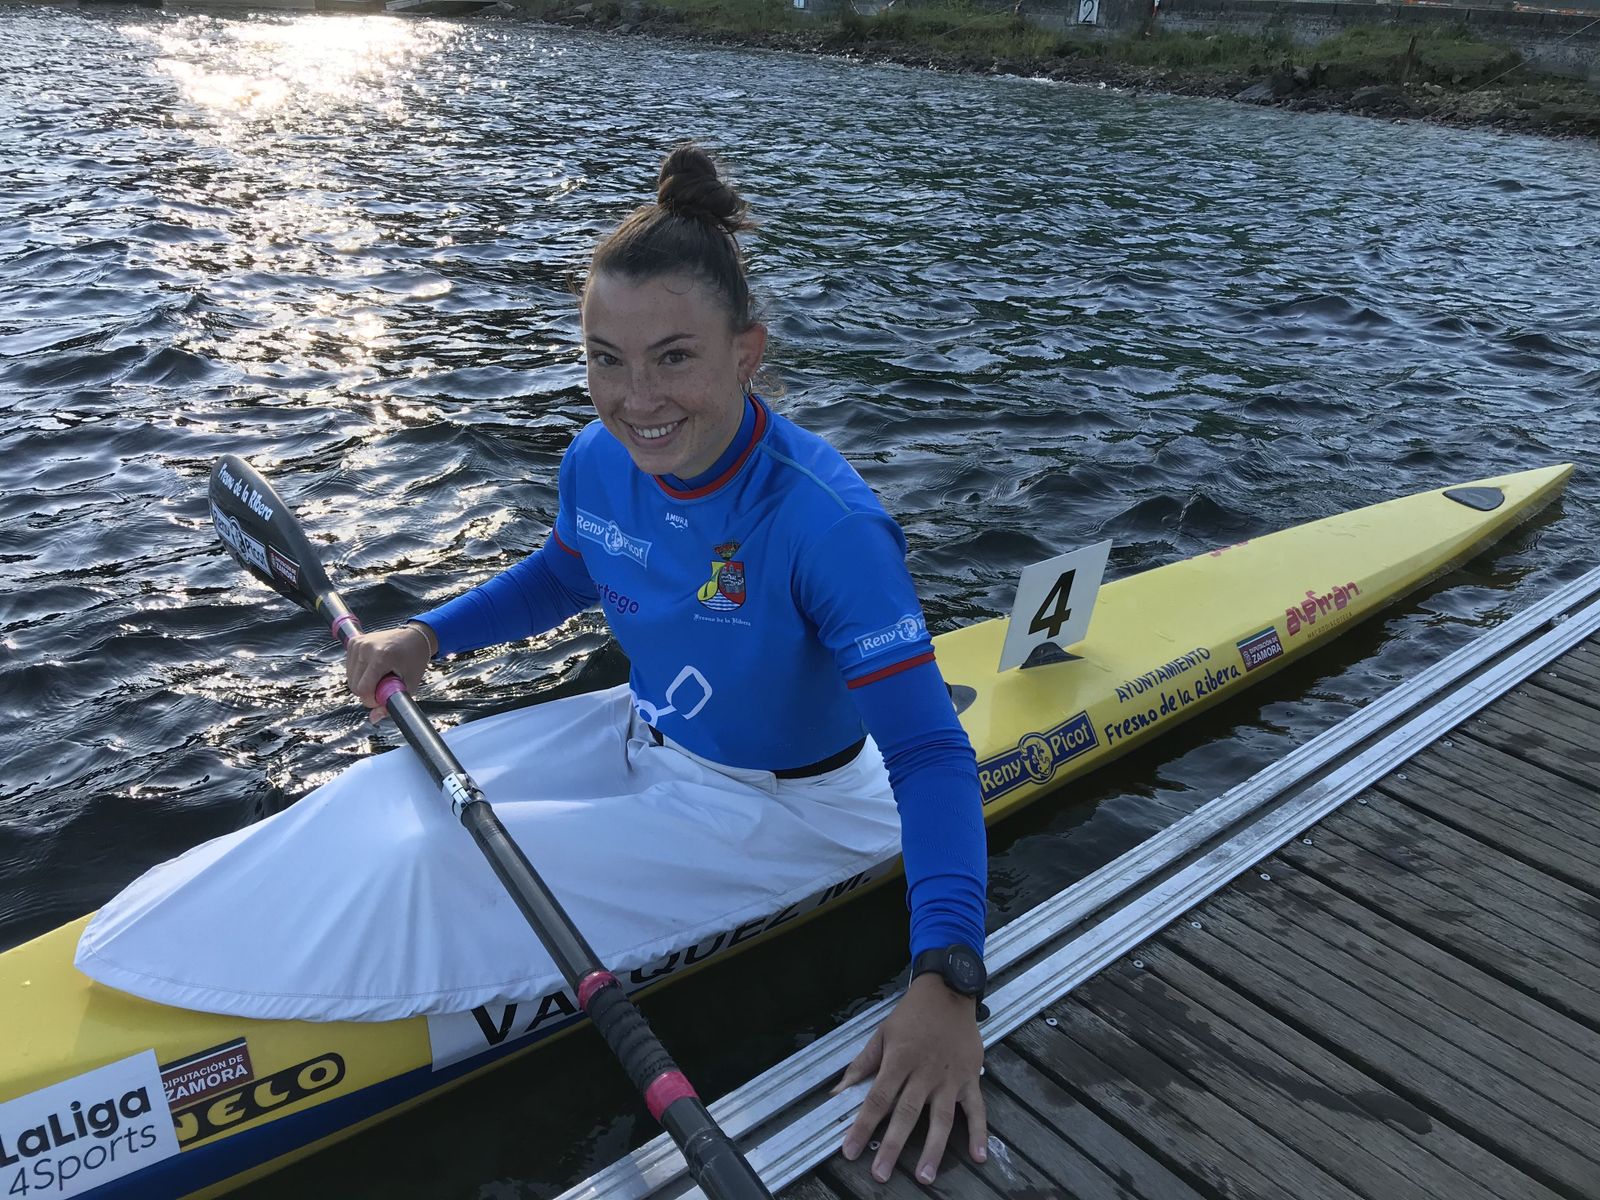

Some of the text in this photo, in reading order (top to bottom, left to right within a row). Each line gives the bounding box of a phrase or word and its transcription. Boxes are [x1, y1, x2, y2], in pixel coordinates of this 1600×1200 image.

[1080, 0, 1095, 23] 2
[241, 484, 249, 504] la
[576, 515, 645, 559] Reny Picot
[665, 512, 688, 528] AMURA
[595, 583, 639, 614] rtego
[1028, 568, 1076, 639] 4
[862, 630, 897, 651] Reny
[1252, 643, 1282, 666] ZAMORA
[1115, 647, 1210, 703] AYUNTAMIENTO
[1104, 664, 1241, 745] Fresno de la Ribera
[978, 723, 1090, 793] Reny Picot
[162, 1054, 245, 1090] DIPUTACIÓN DE
[165, 1064, 249, 1101] ZAMORA
[0, 1086, 151, 1168] LaLiga
[8, 1124, 157, 1196] 4Sports
